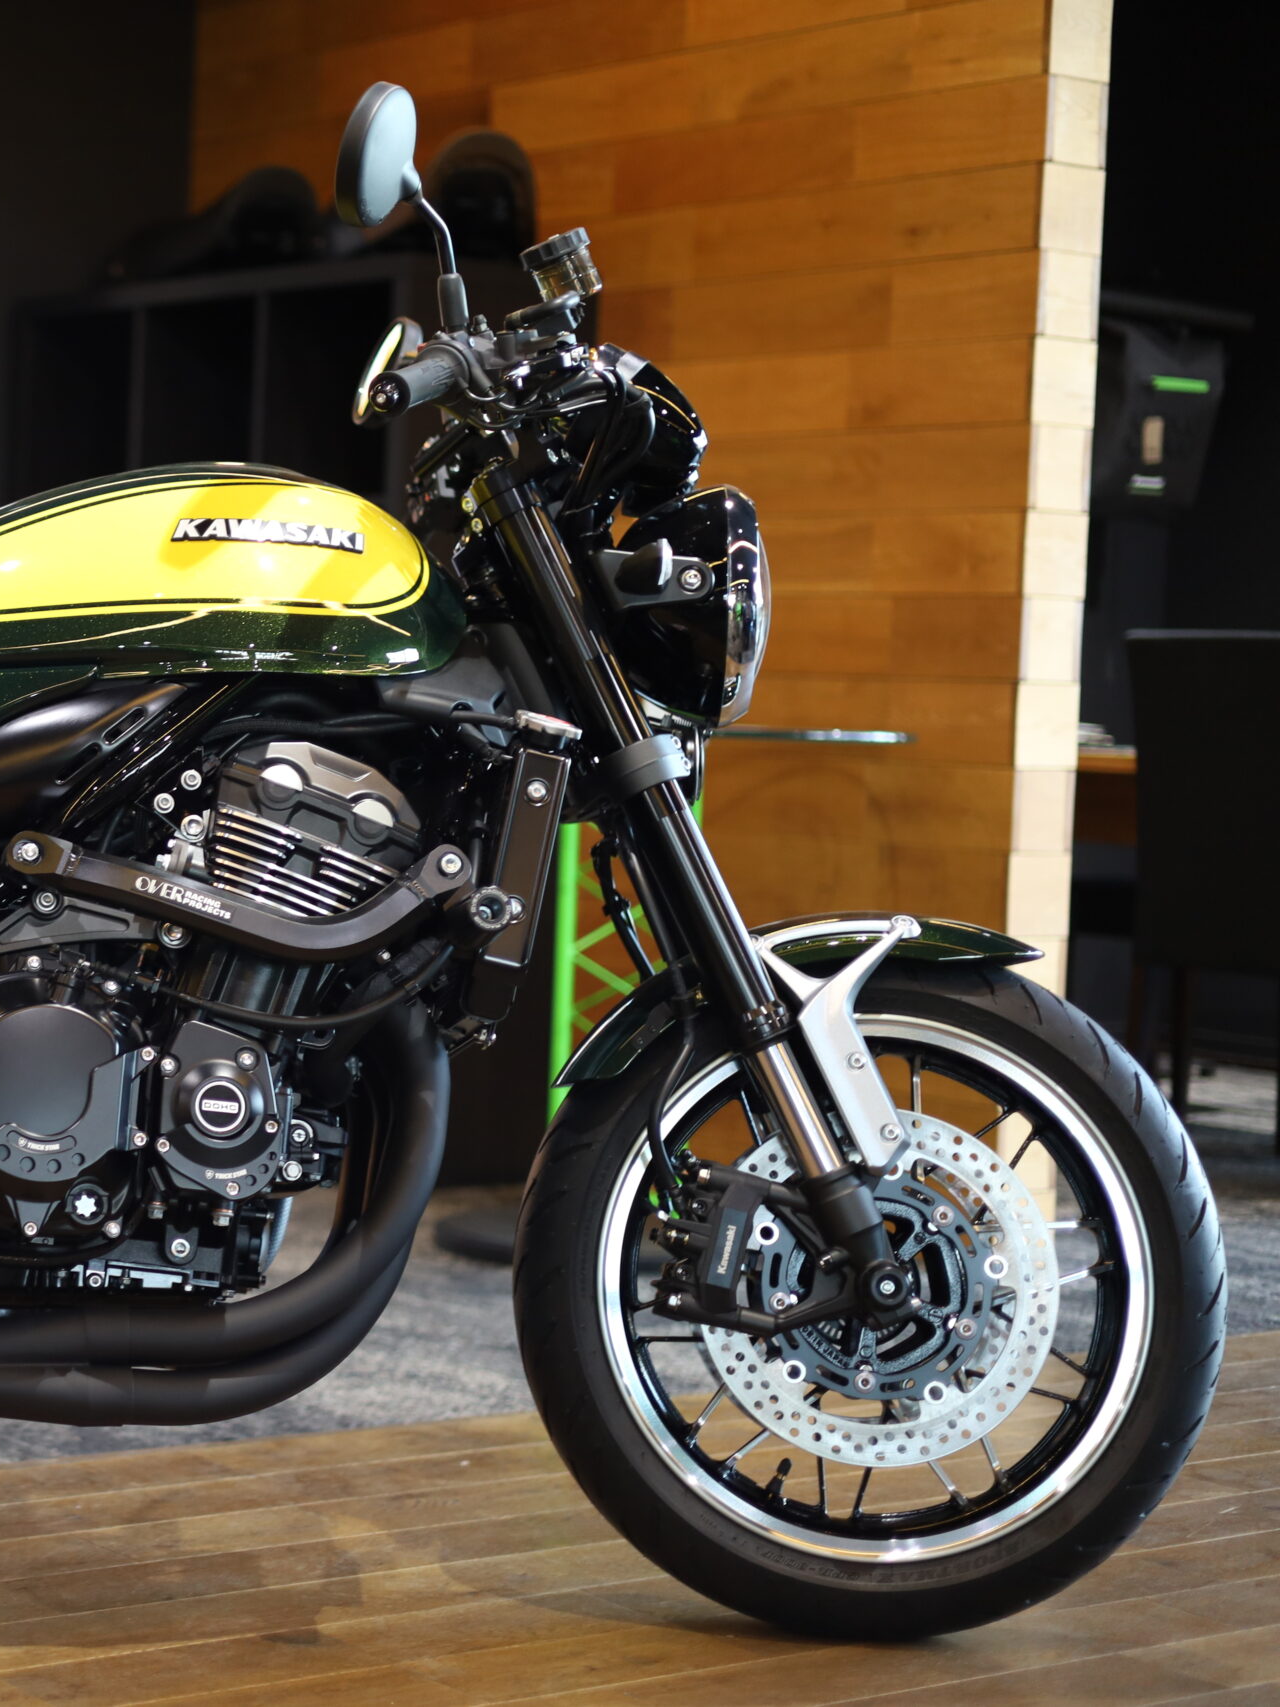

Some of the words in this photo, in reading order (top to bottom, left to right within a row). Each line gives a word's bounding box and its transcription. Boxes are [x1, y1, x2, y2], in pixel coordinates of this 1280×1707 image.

[171, 518, 365, 554] KAWASAKI
[135, 876, 185, 903] OVER
[184, 890, 221, 908] RACING
[182, 898, 231, 919] PROJECTS
[203, 1101, 238, 1112] DOHC
[717, 1224, 737, 1274] Kawasaki
